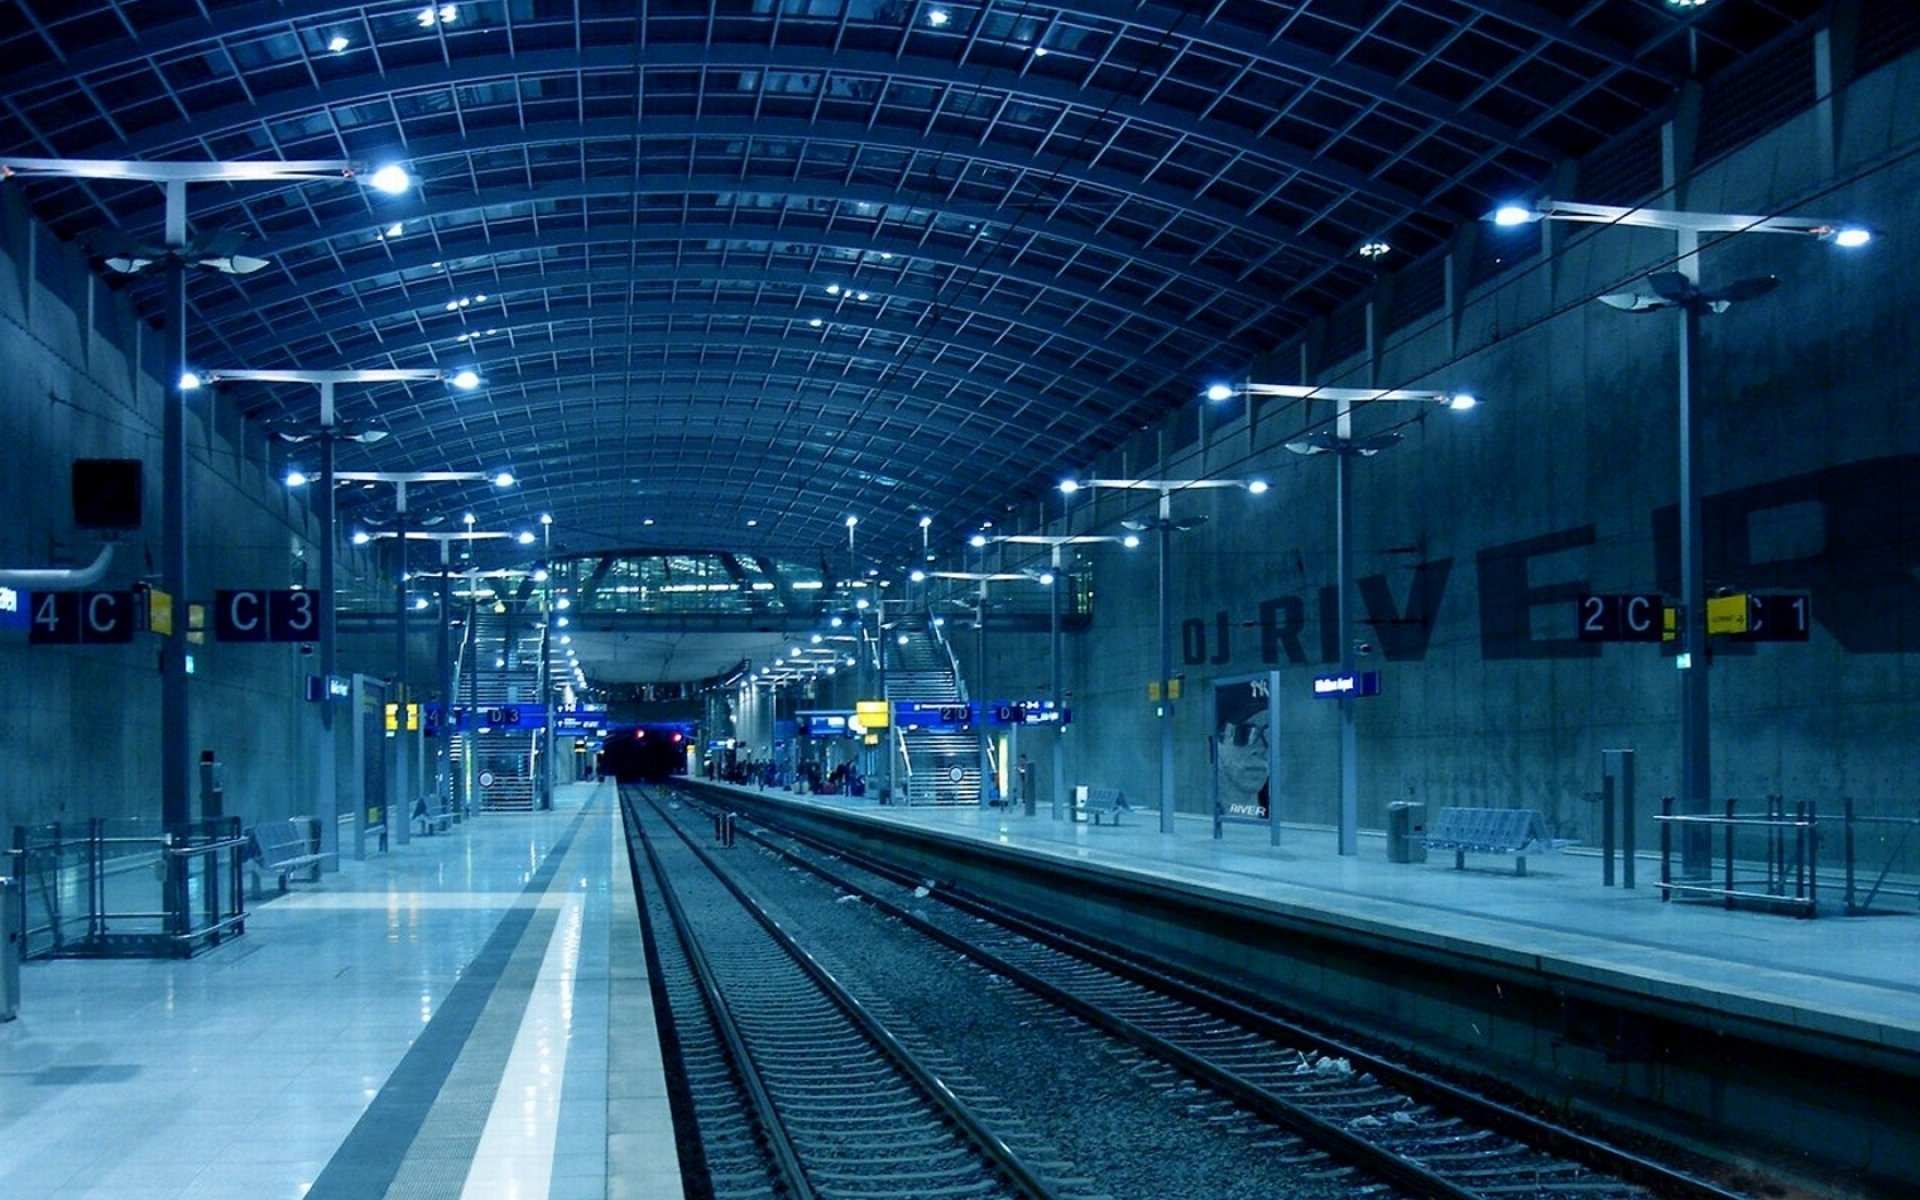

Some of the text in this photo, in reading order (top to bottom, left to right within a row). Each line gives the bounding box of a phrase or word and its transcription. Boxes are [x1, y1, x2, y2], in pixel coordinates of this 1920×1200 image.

[1183, 453, 1920, 666] DJ RIVER
[35, 593, 59, 631] 4
[89, 592, 116, 633] C
[231, 591, 313, 631] C 3
[1584, 596, 1650, 631] 2 C
[1792, 598, 1804, 631] 1
[492, 709, 519, 722] D 3
[942, 707, 951, 720] 2
[1001, 707, 1010, 720] D
[1229, 803, 1267, 817] RIVER
